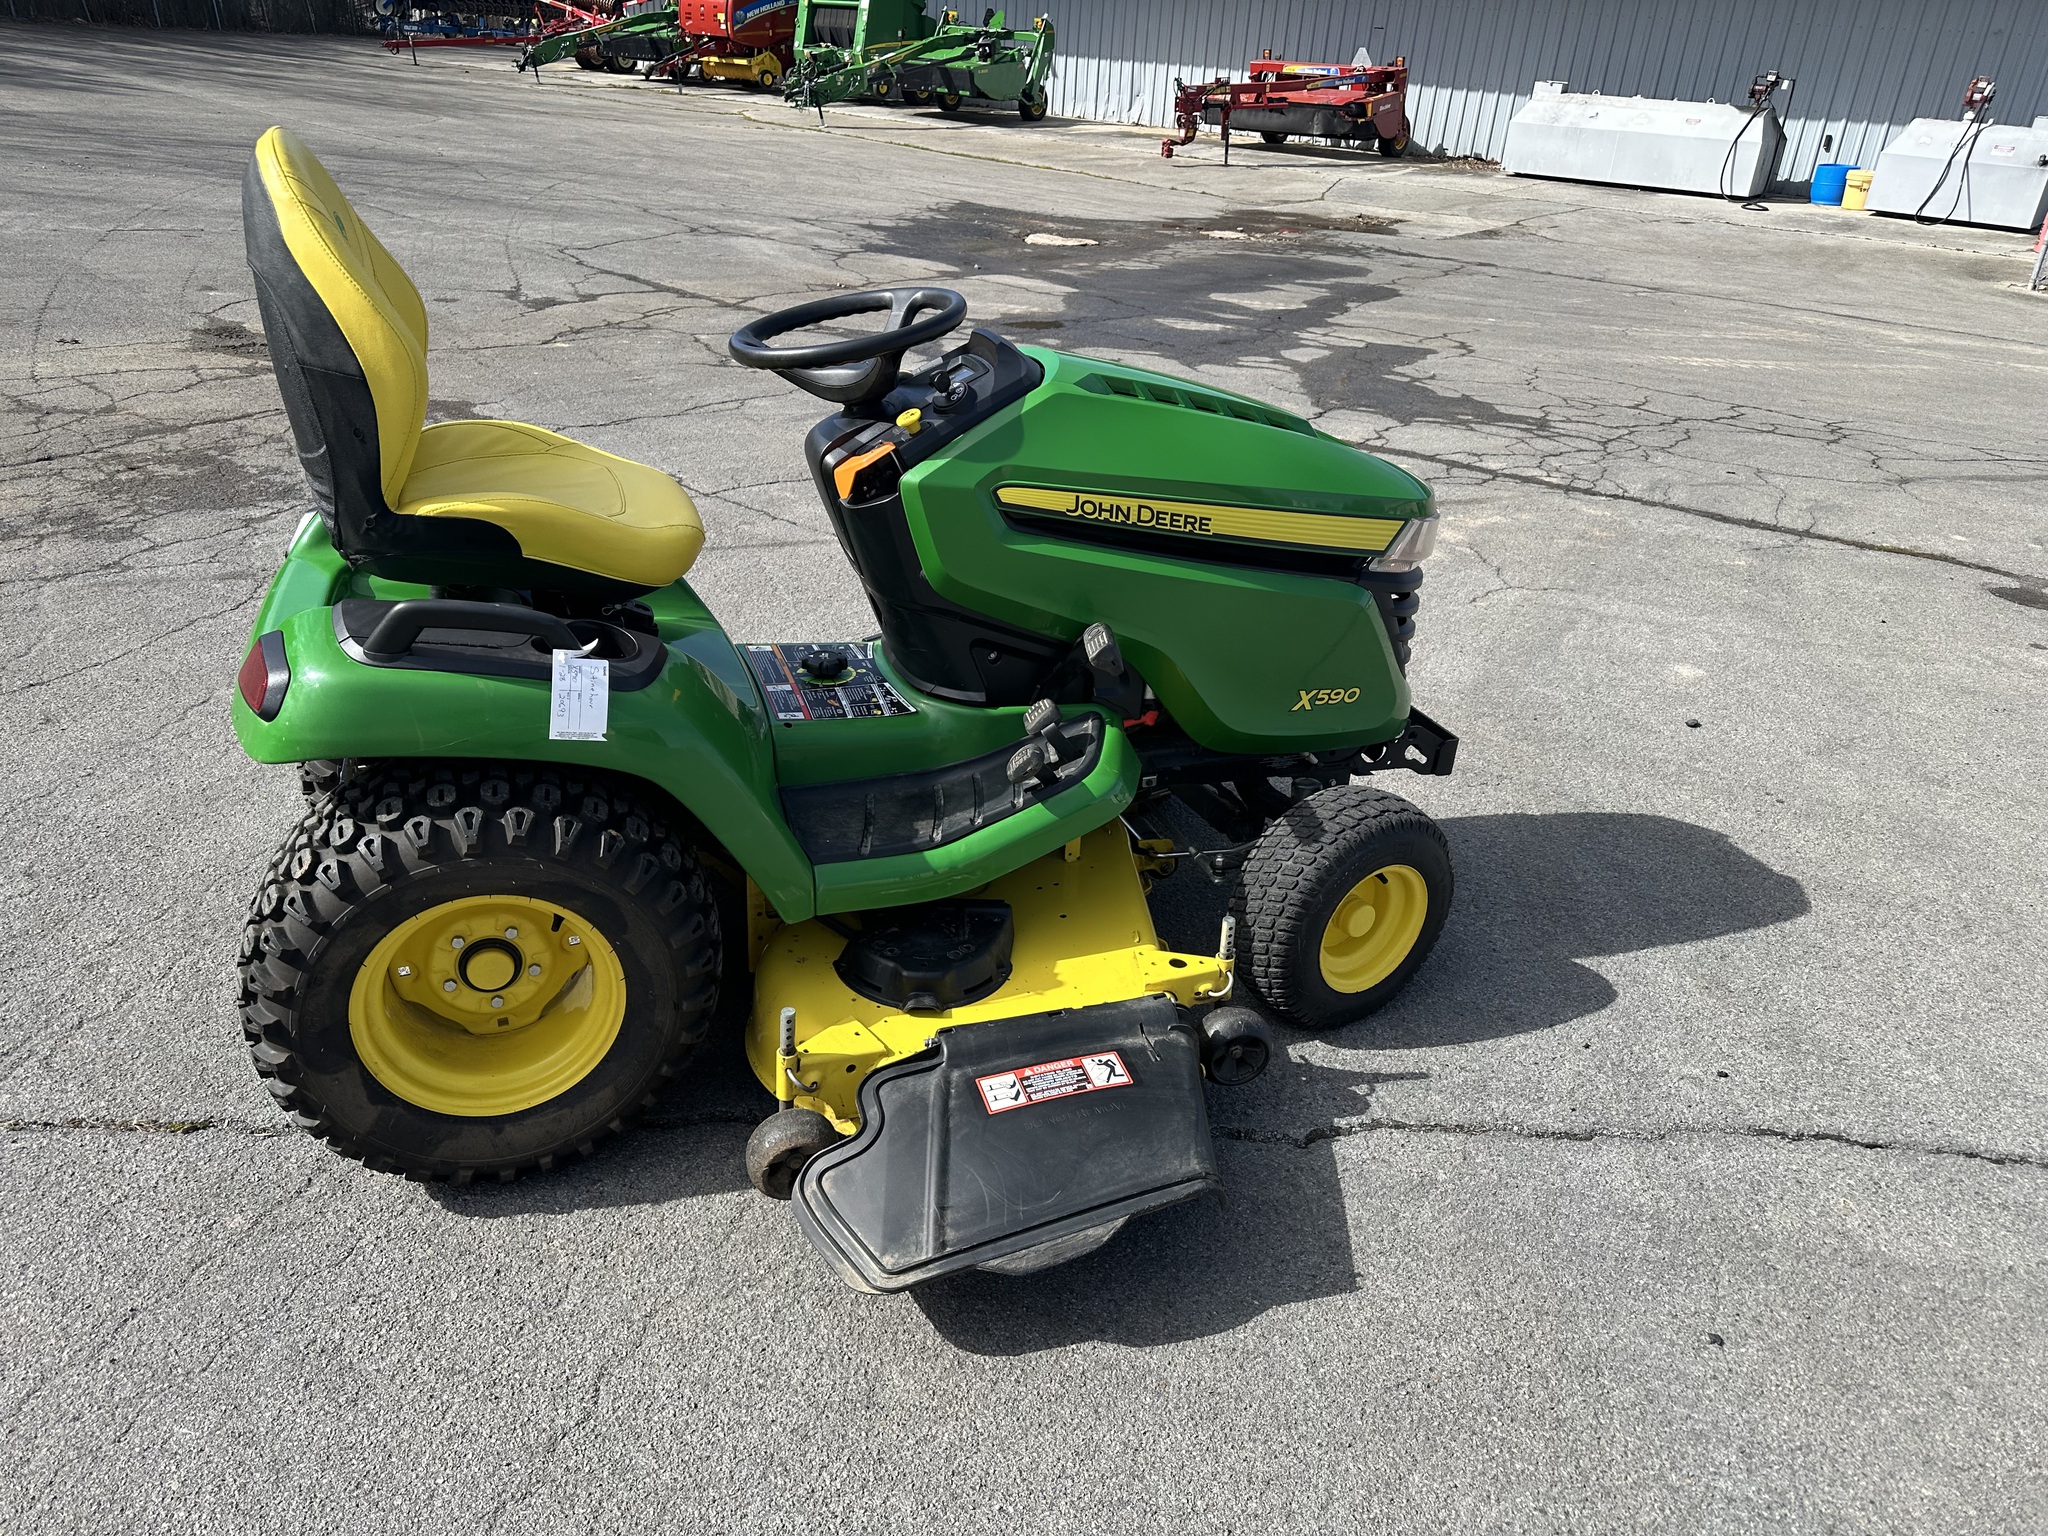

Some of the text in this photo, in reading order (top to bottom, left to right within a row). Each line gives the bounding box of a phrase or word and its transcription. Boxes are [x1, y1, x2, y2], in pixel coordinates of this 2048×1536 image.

[746, 0, 786, 19] NEW HOLLAND
[1065, 494, 1213, 535] JOHN DEERE
[1289, 686, 1361, 712] X590
[1033, 1061, 1075, 1073] DANGER
